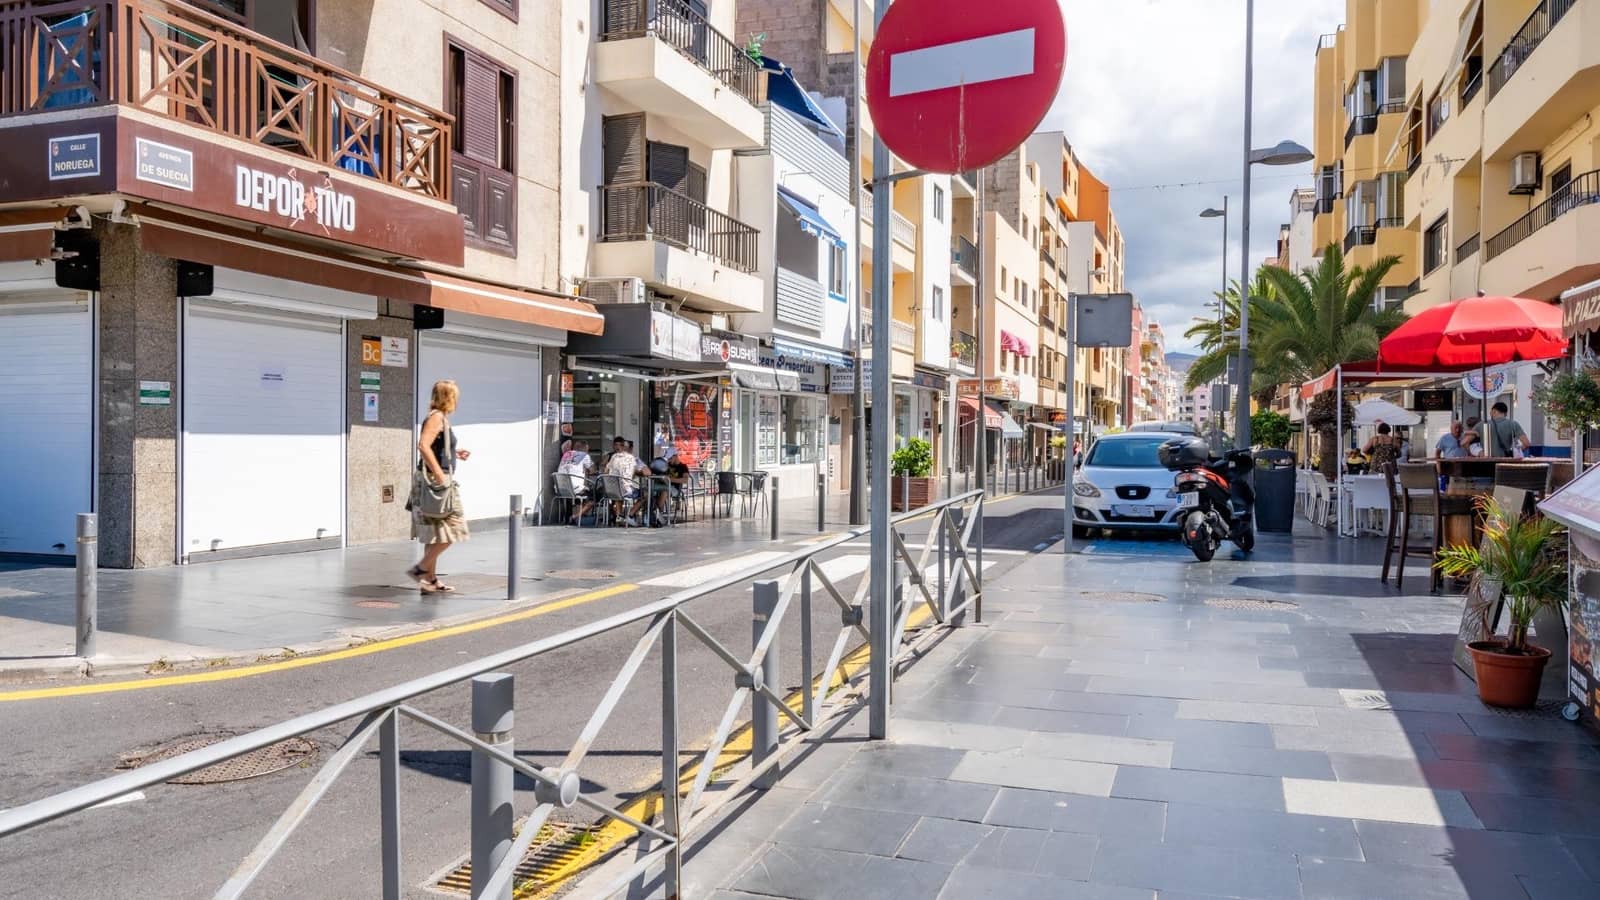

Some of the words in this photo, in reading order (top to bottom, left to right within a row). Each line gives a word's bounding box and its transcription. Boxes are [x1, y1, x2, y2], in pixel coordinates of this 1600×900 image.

[55, 159, 94, 172] NORUEGA
[141, 163, 154, 175] DE
[156, 166, 189, 184] SUECIA
[362, 342, 380, 362] Bc
